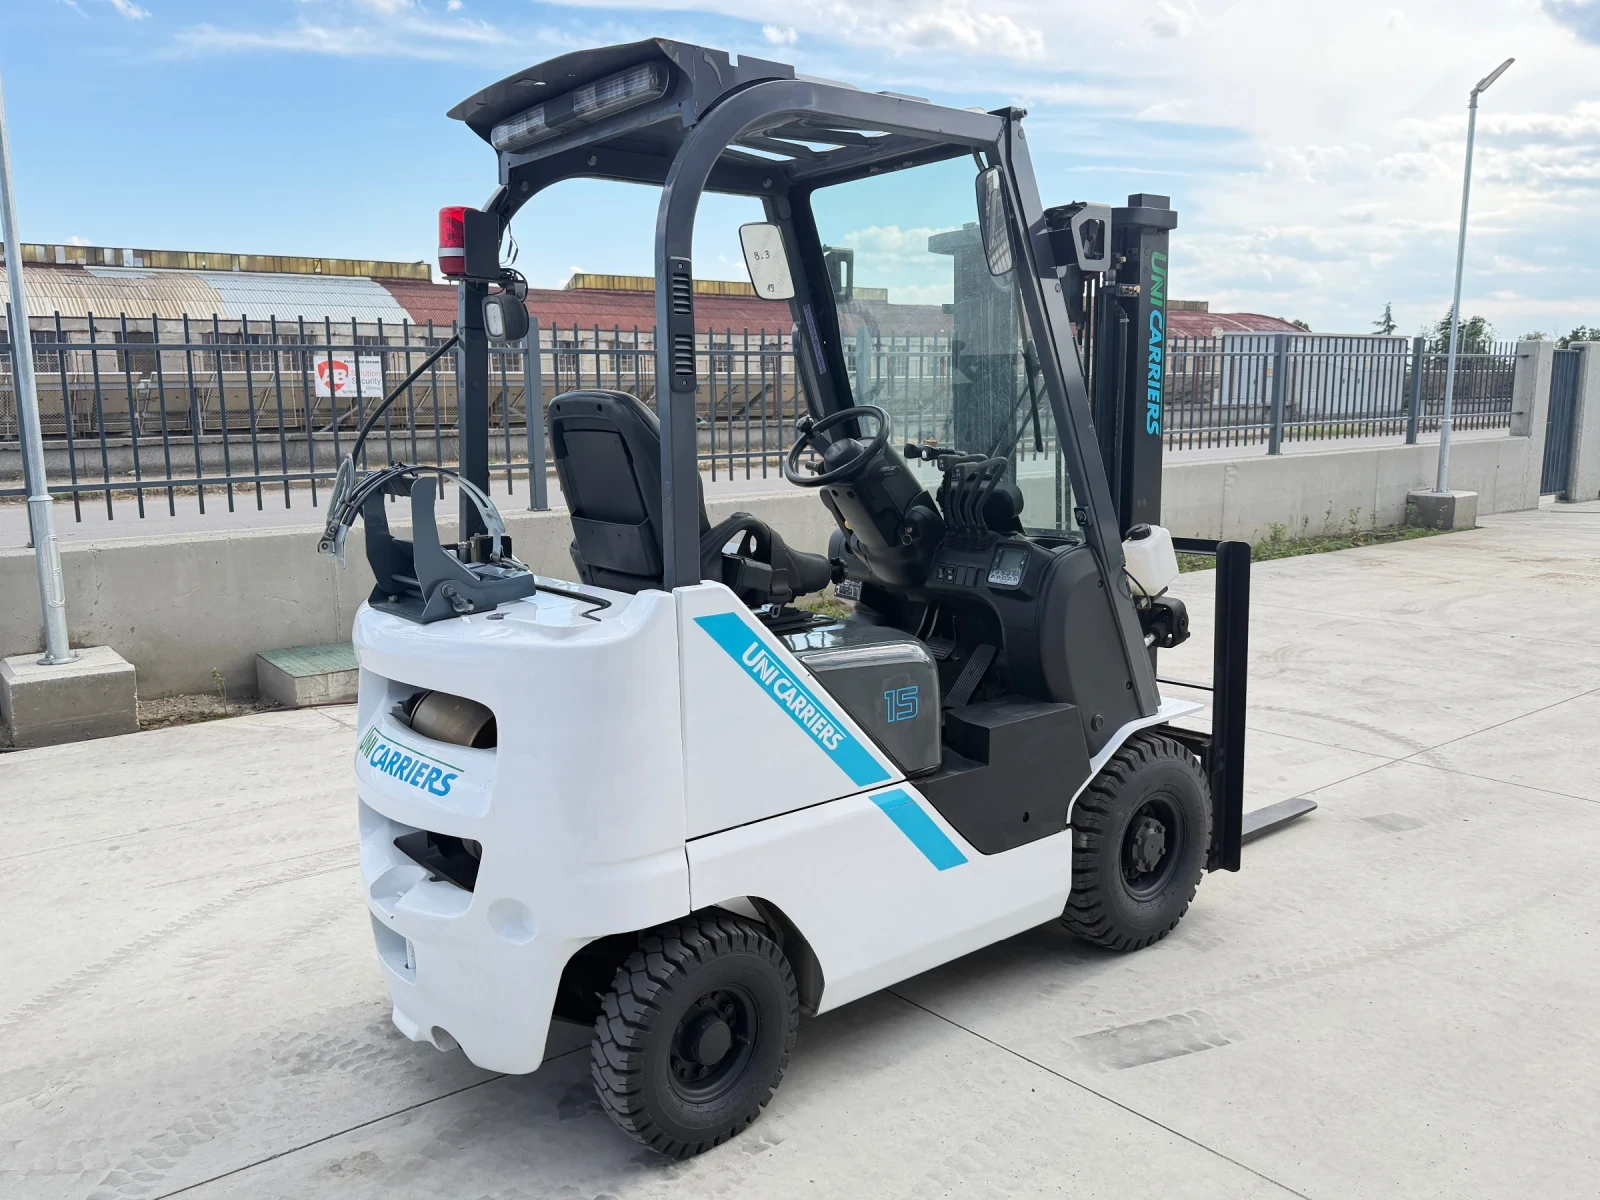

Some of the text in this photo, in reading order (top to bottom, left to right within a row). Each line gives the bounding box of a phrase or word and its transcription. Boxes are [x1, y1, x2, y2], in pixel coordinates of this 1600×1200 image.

[754, 250, 770, 261] 8.3
[352, 378, 381, 386] Scurity
[884, 686, 919, 723] 15
